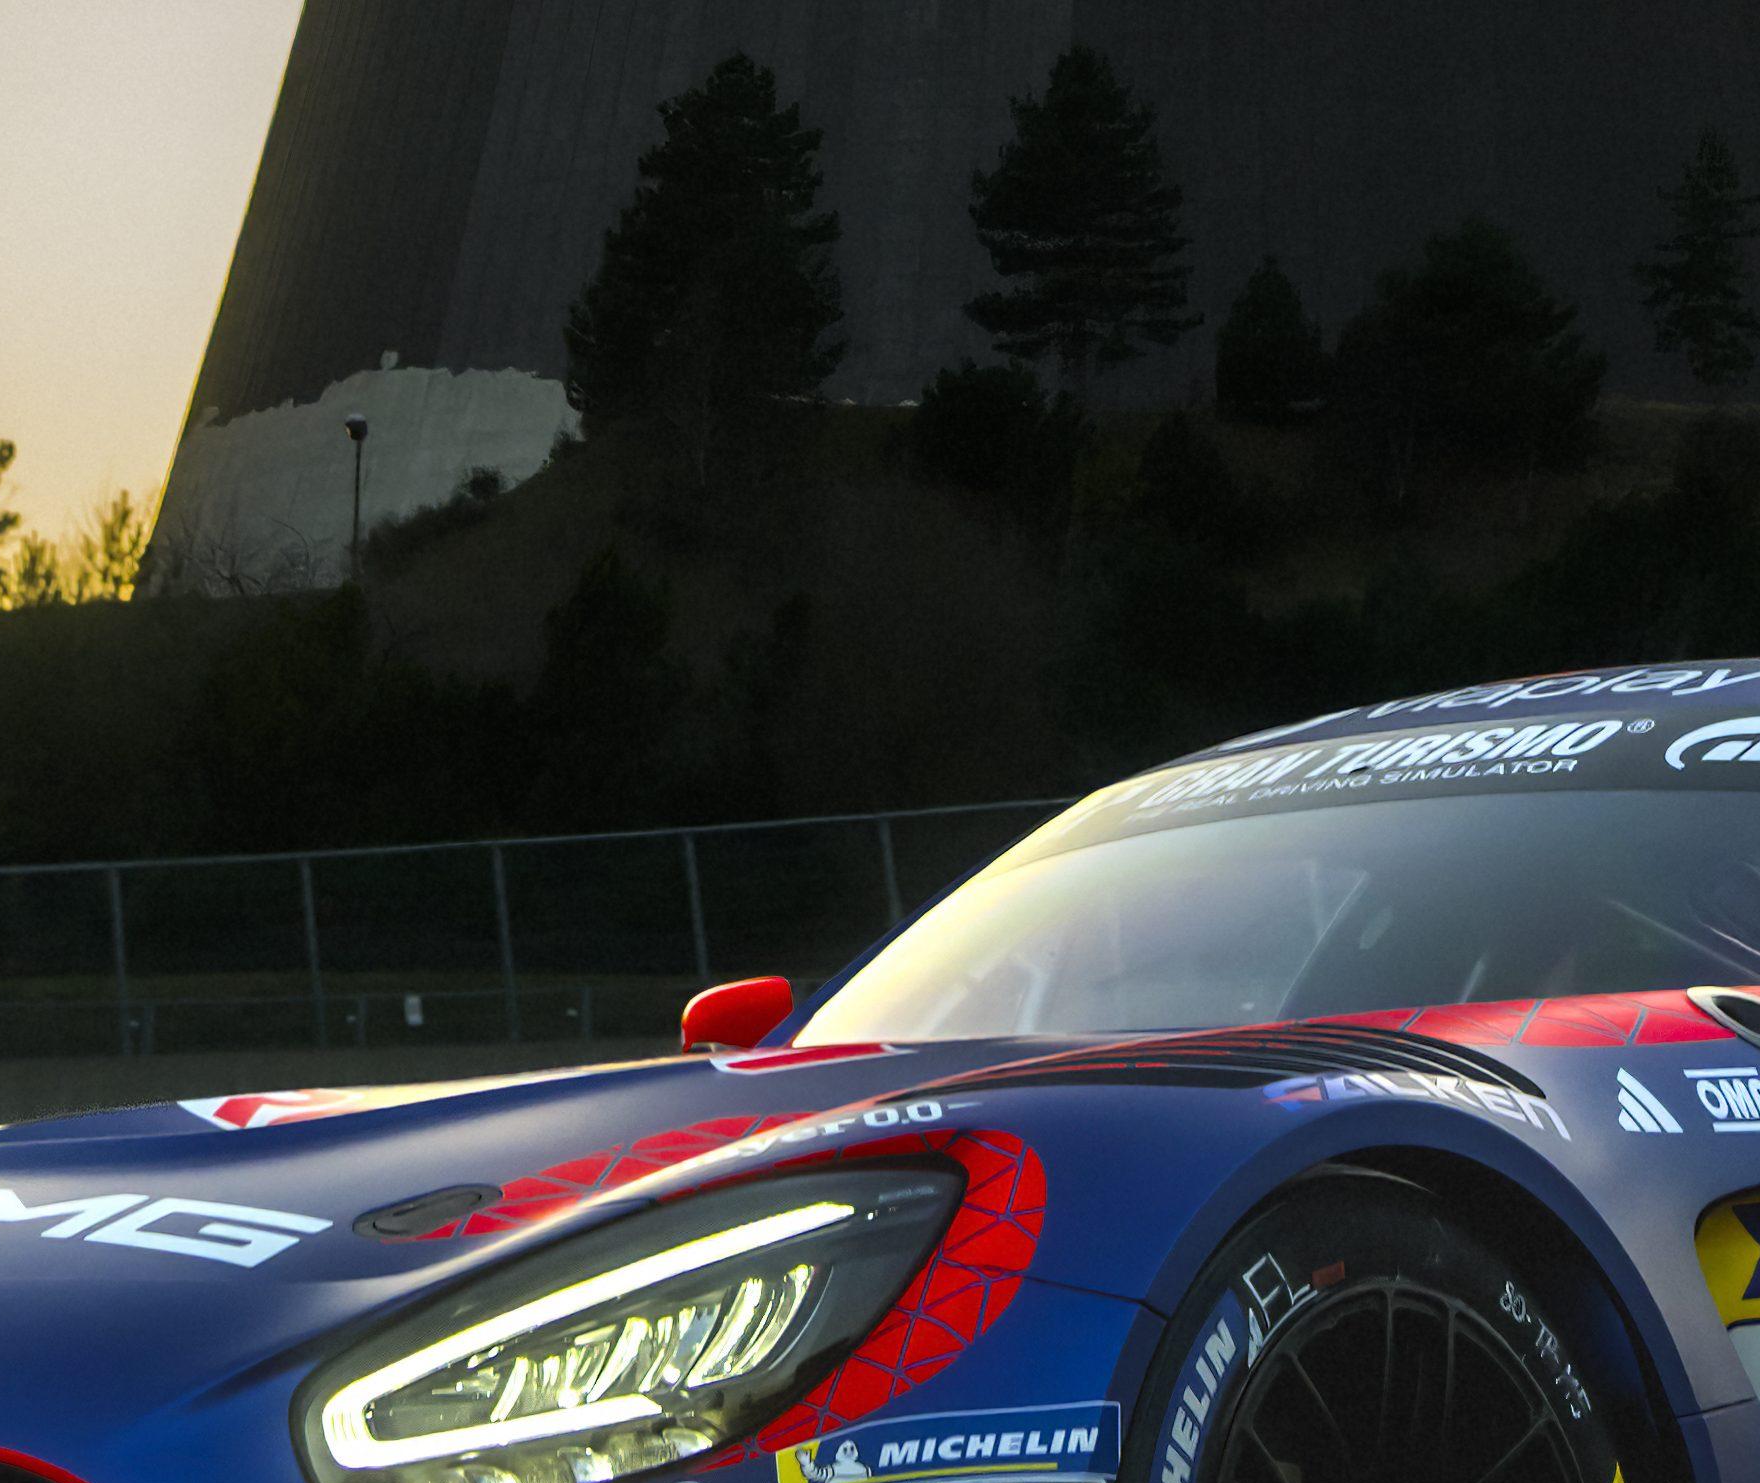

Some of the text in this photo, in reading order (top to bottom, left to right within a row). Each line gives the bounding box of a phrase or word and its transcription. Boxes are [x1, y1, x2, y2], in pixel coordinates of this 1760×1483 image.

[1138, 749, 1323, 809] GRAN
[1380, 757, 1578, 785] SIMULATOR
[862, 1100, 943, 1127] 0.0
[877, 1426, 1100, 1468] MICHELIN
